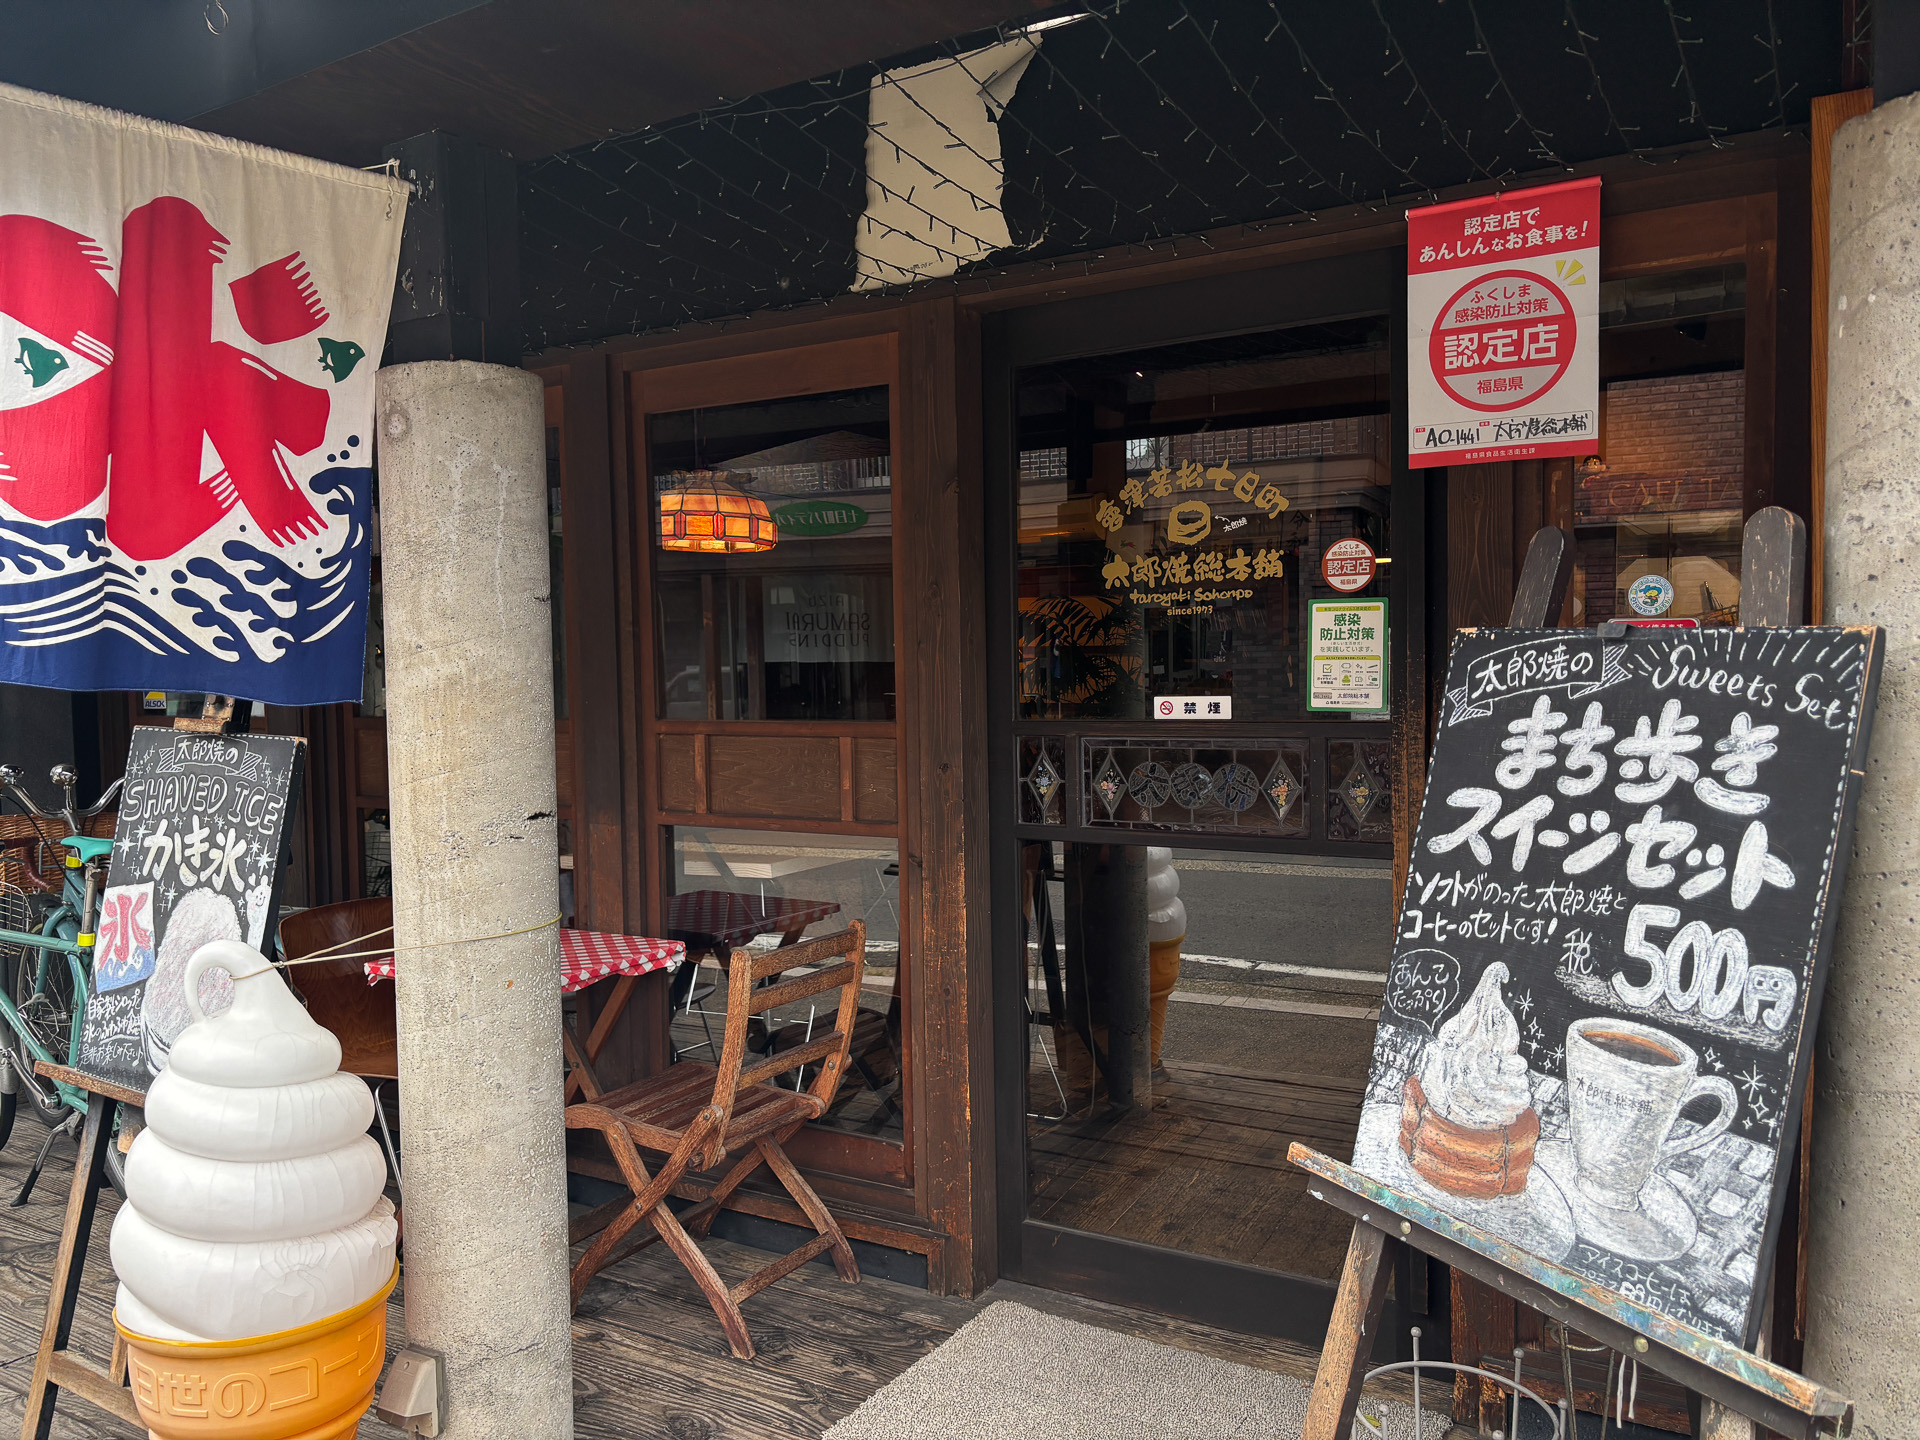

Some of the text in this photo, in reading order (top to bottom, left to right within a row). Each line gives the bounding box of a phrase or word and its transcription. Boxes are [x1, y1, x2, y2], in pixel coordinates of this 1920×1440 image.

[1464, 207, 1540, 236] 認定店で
[1470, 284, 1531, 304] ふくしま
[1454, 298, 1549, 323] 感染防止対策
[1443, 322, 1560, 370] 認定店
[1476, 376, 1524, 395] 福島県
[1101, 548, 1285, 590] 太郎焼総本舗
[1327, 558, 1371, 575] 認定店
[1320, 627, 1375, 641] 防止対策
[1333, 613, 1362, 627] 感染
[1472, 642, 1594, 698] 太郎焼の
[1652, 644, 1778, 708] Sweets
[144, 700, 166, 708] ALSOK
[1184, 702, 1221, 714] 禁煙
[175, 738, 239, 764] 太郎焼の
[1495, 694, 1780, 815] まち歩き
[121, 774, 284, 835] SHAVED ICE
[142, 814, 248, 893] かき氷
[1427, 787, 1796, 911] スイーツセット
[98, 892, 152, 970] 氷
[1394, 958, 1450, 990] あんこ
[1611, 904, 1798, 1031] 500円
[1392, 986, 1447, 1013] たっぷり
